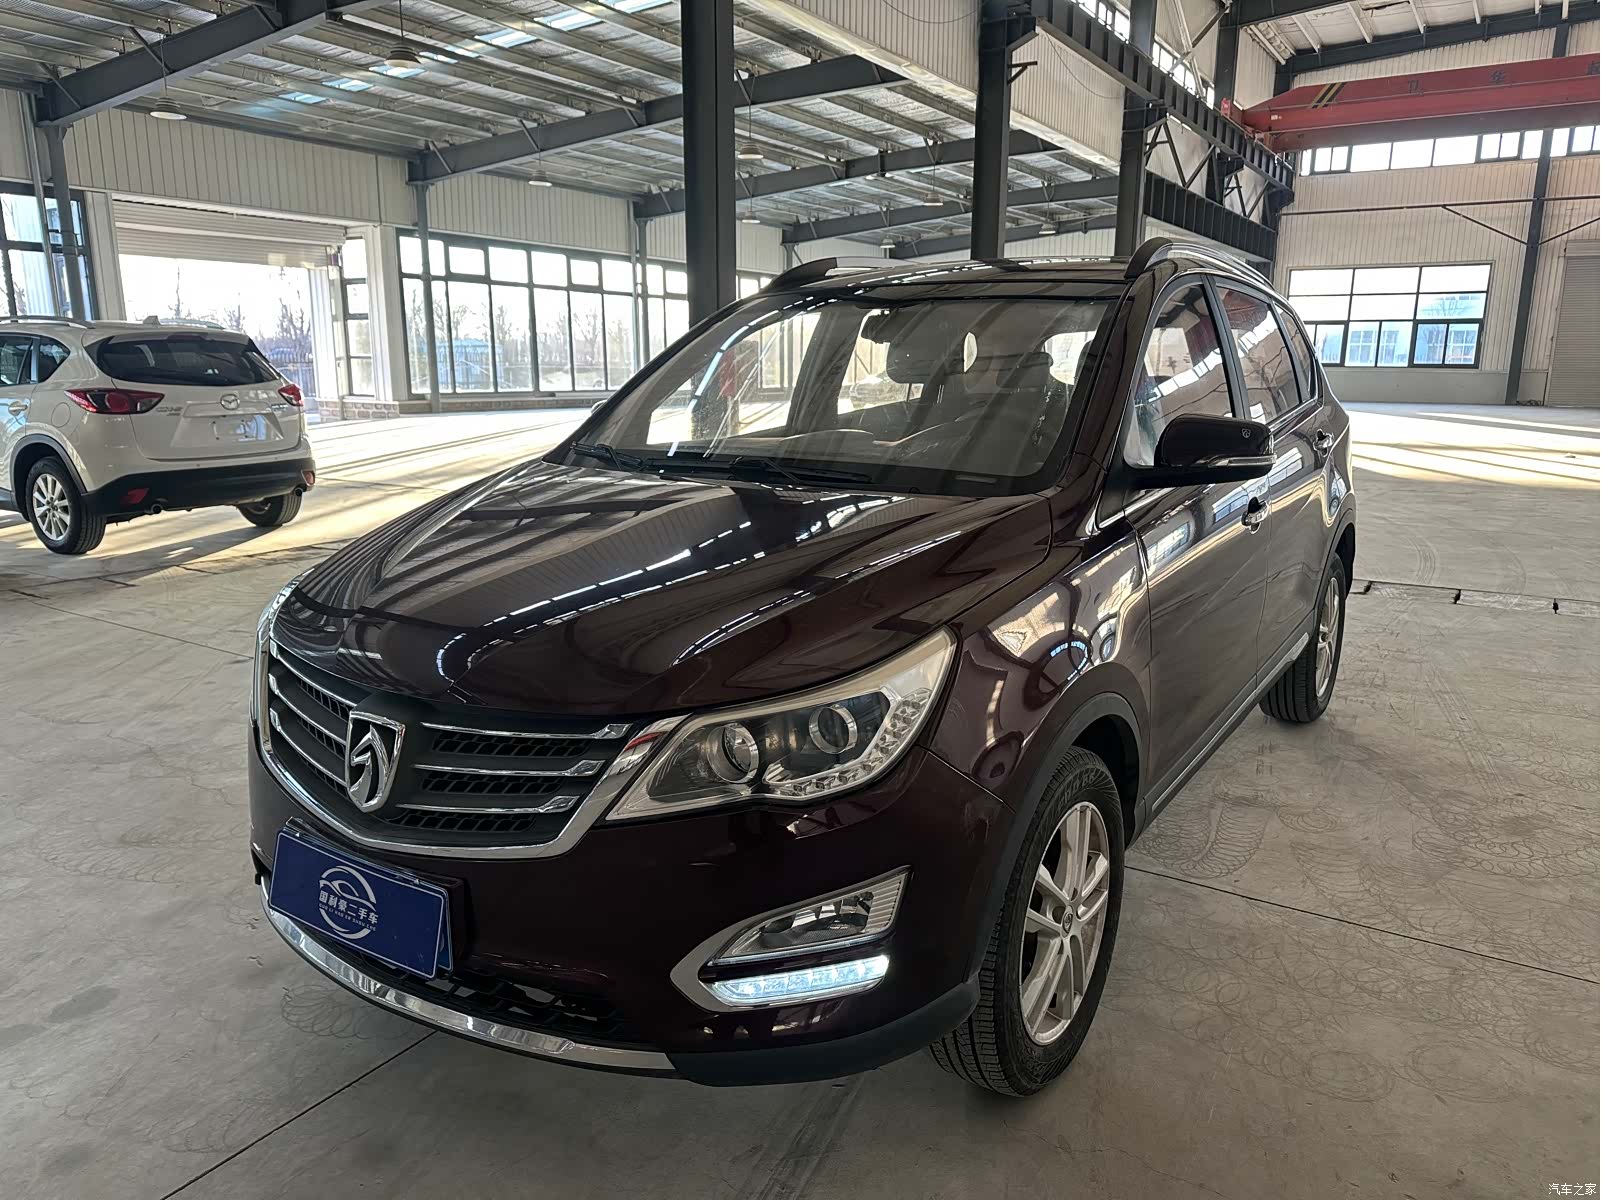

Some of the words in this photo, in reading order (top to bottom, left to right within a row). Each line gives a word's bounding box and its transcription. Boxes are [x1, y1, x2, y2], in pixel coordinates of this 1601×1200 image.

[319, 890, 379, 925] 国利豪二手车
